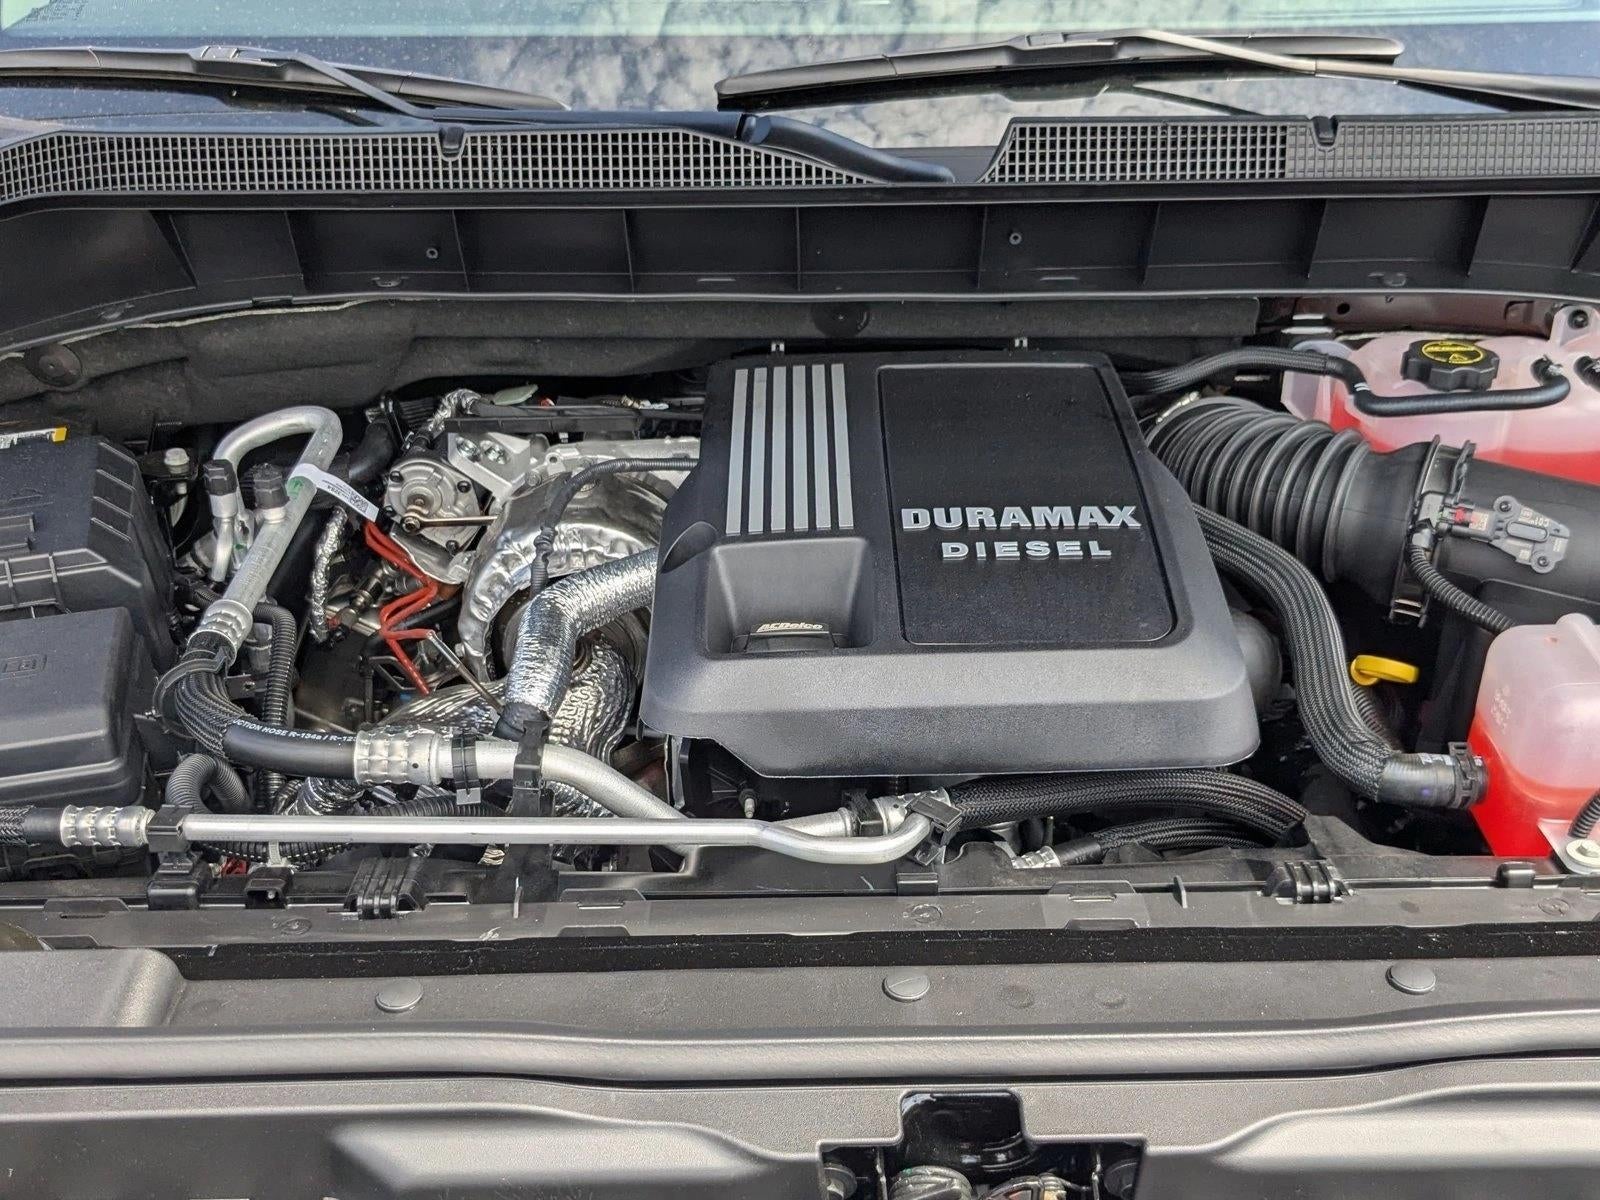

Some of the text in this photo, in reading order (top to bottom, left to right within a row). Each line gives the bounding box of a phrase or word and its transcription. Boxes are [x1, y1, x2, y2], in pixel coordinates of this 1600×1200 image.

[901, 506, 1142, 530] DURAMAX
[941, 540, 1112, 560] DIESEL
[262, 727, 288, 737] HOSE
[288, 731, 322, 740] R-134a
